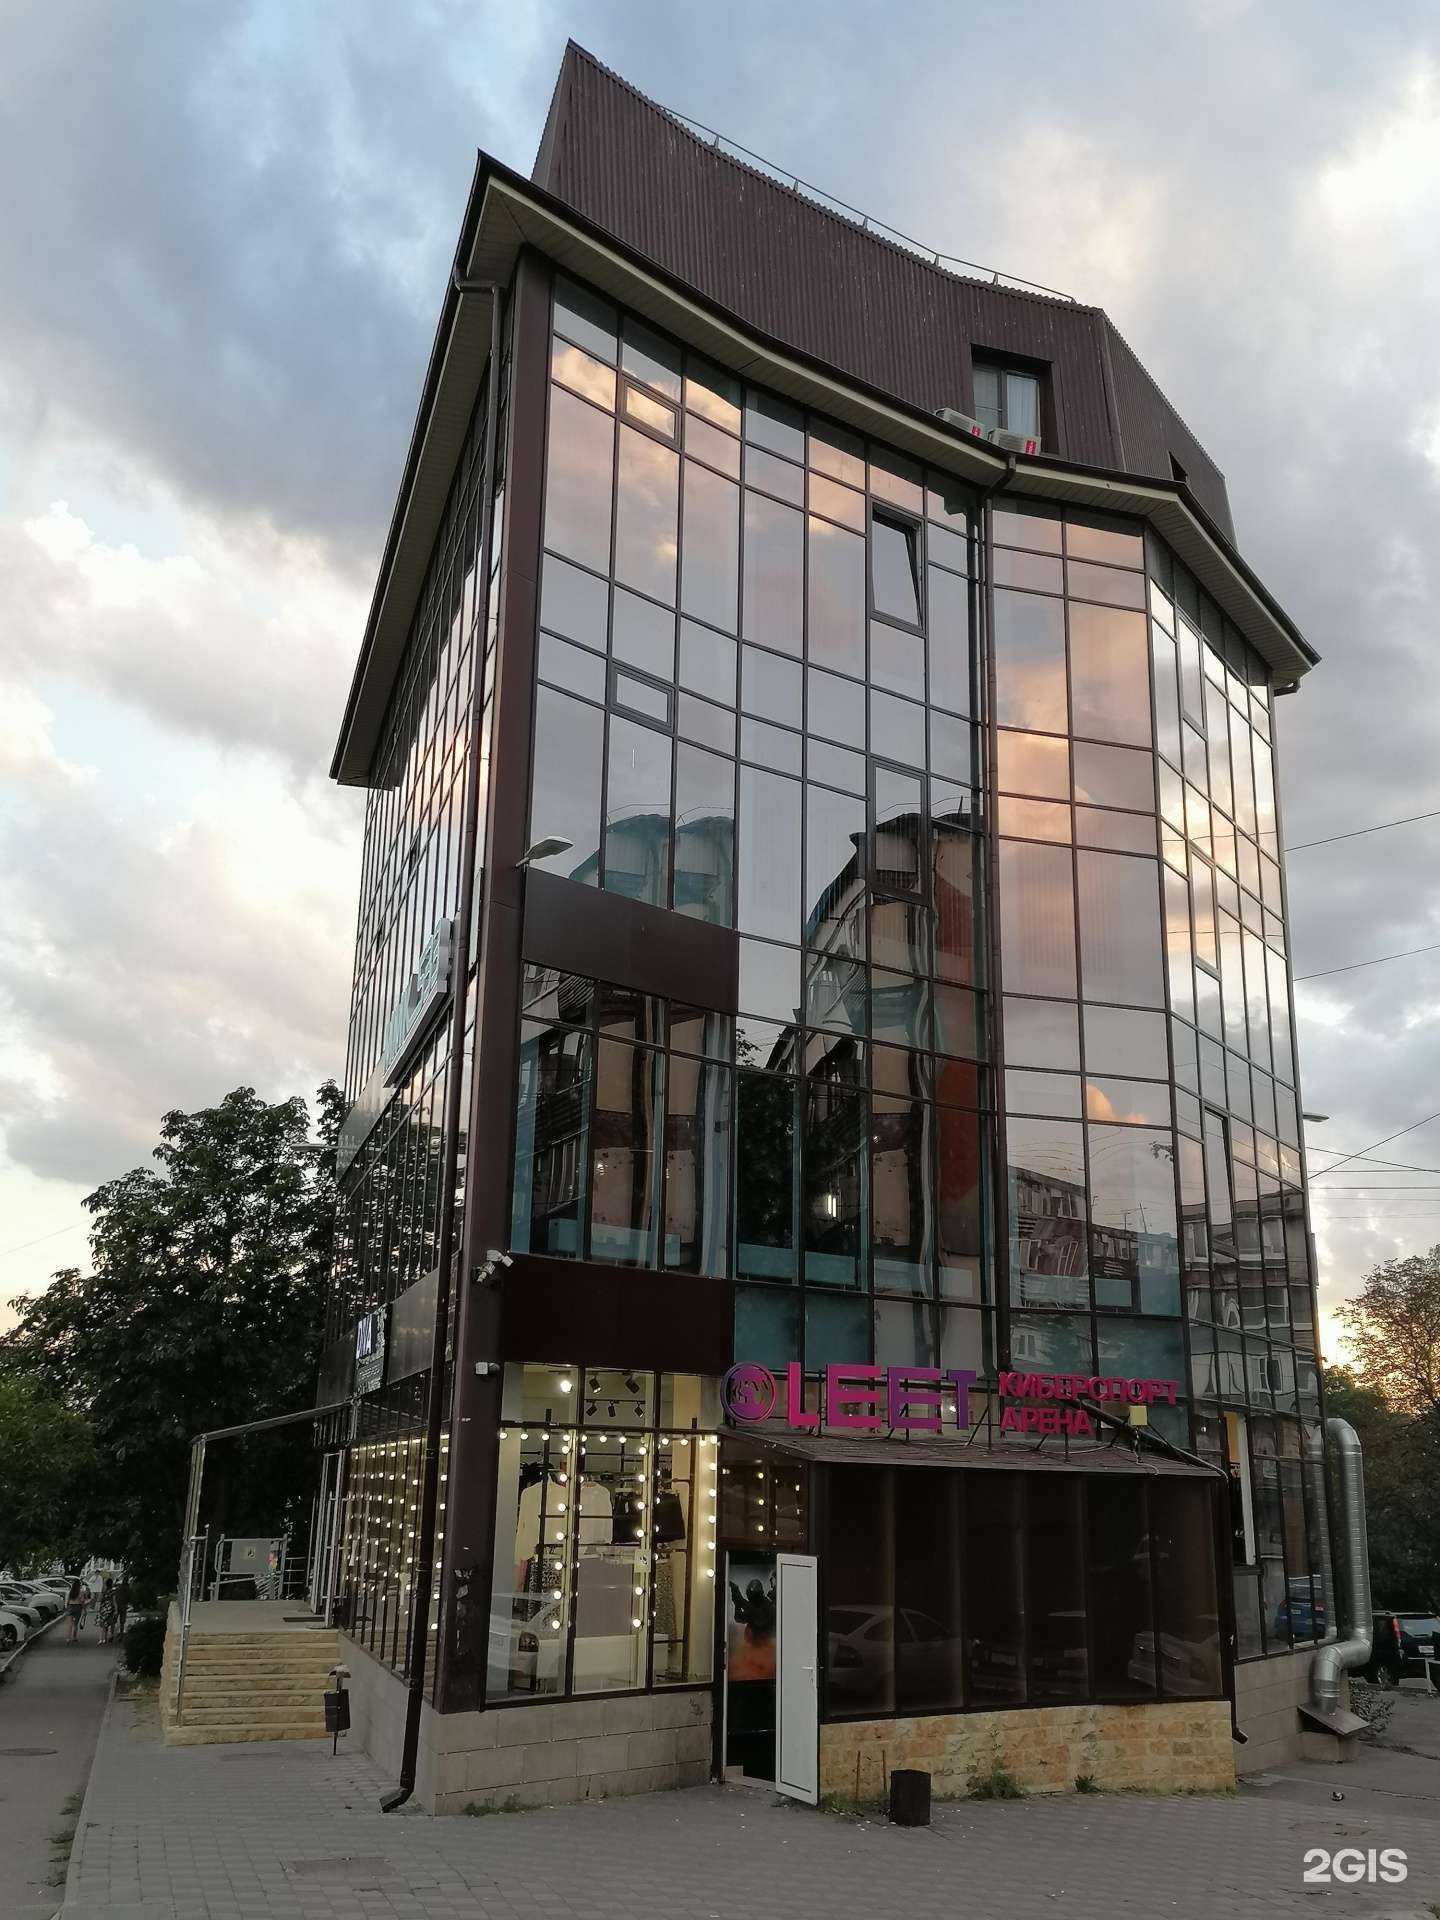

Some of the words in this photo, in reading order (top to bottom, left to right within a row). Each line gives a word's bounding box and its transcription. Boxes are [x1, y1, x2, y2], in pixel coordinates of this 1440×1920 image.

[787, 1361, 977, 1430] LEET
[998, 1371, 1181, 1406] КИБЕРСПОРТ
[1000, 1406, 1095, 1436] АРЕНА
